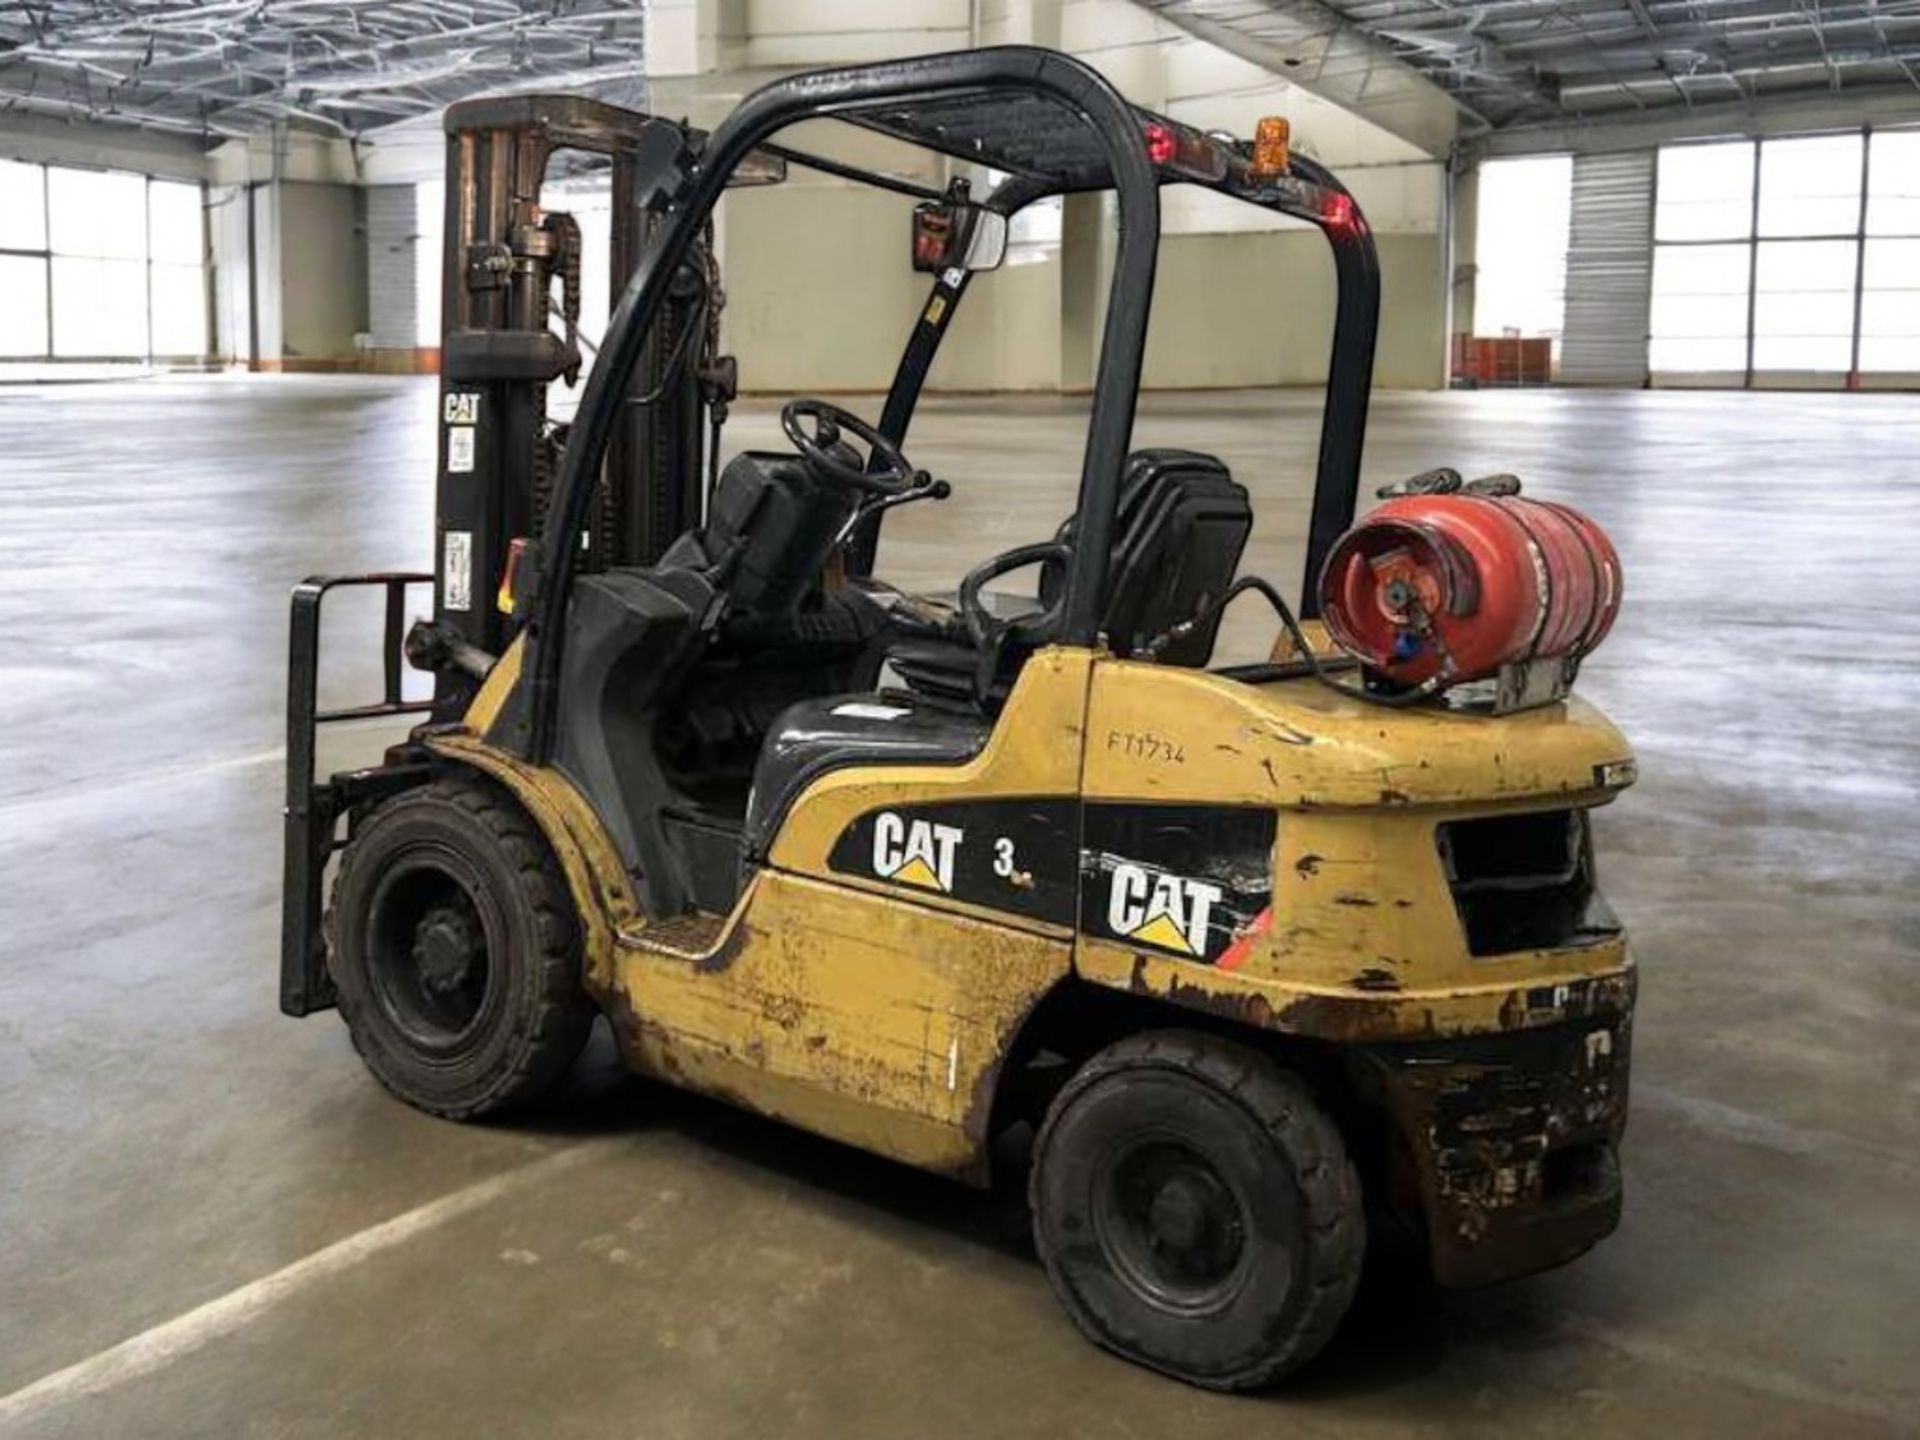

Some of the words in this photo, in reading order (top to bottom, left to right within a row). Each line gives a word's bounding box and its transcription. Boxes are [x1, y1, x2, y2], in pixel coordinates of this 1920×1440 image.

[445, 393, 481, 424] CAT
[873, 811, 963, 892] CAT
[1109, 864, 1222, 956] CAT
